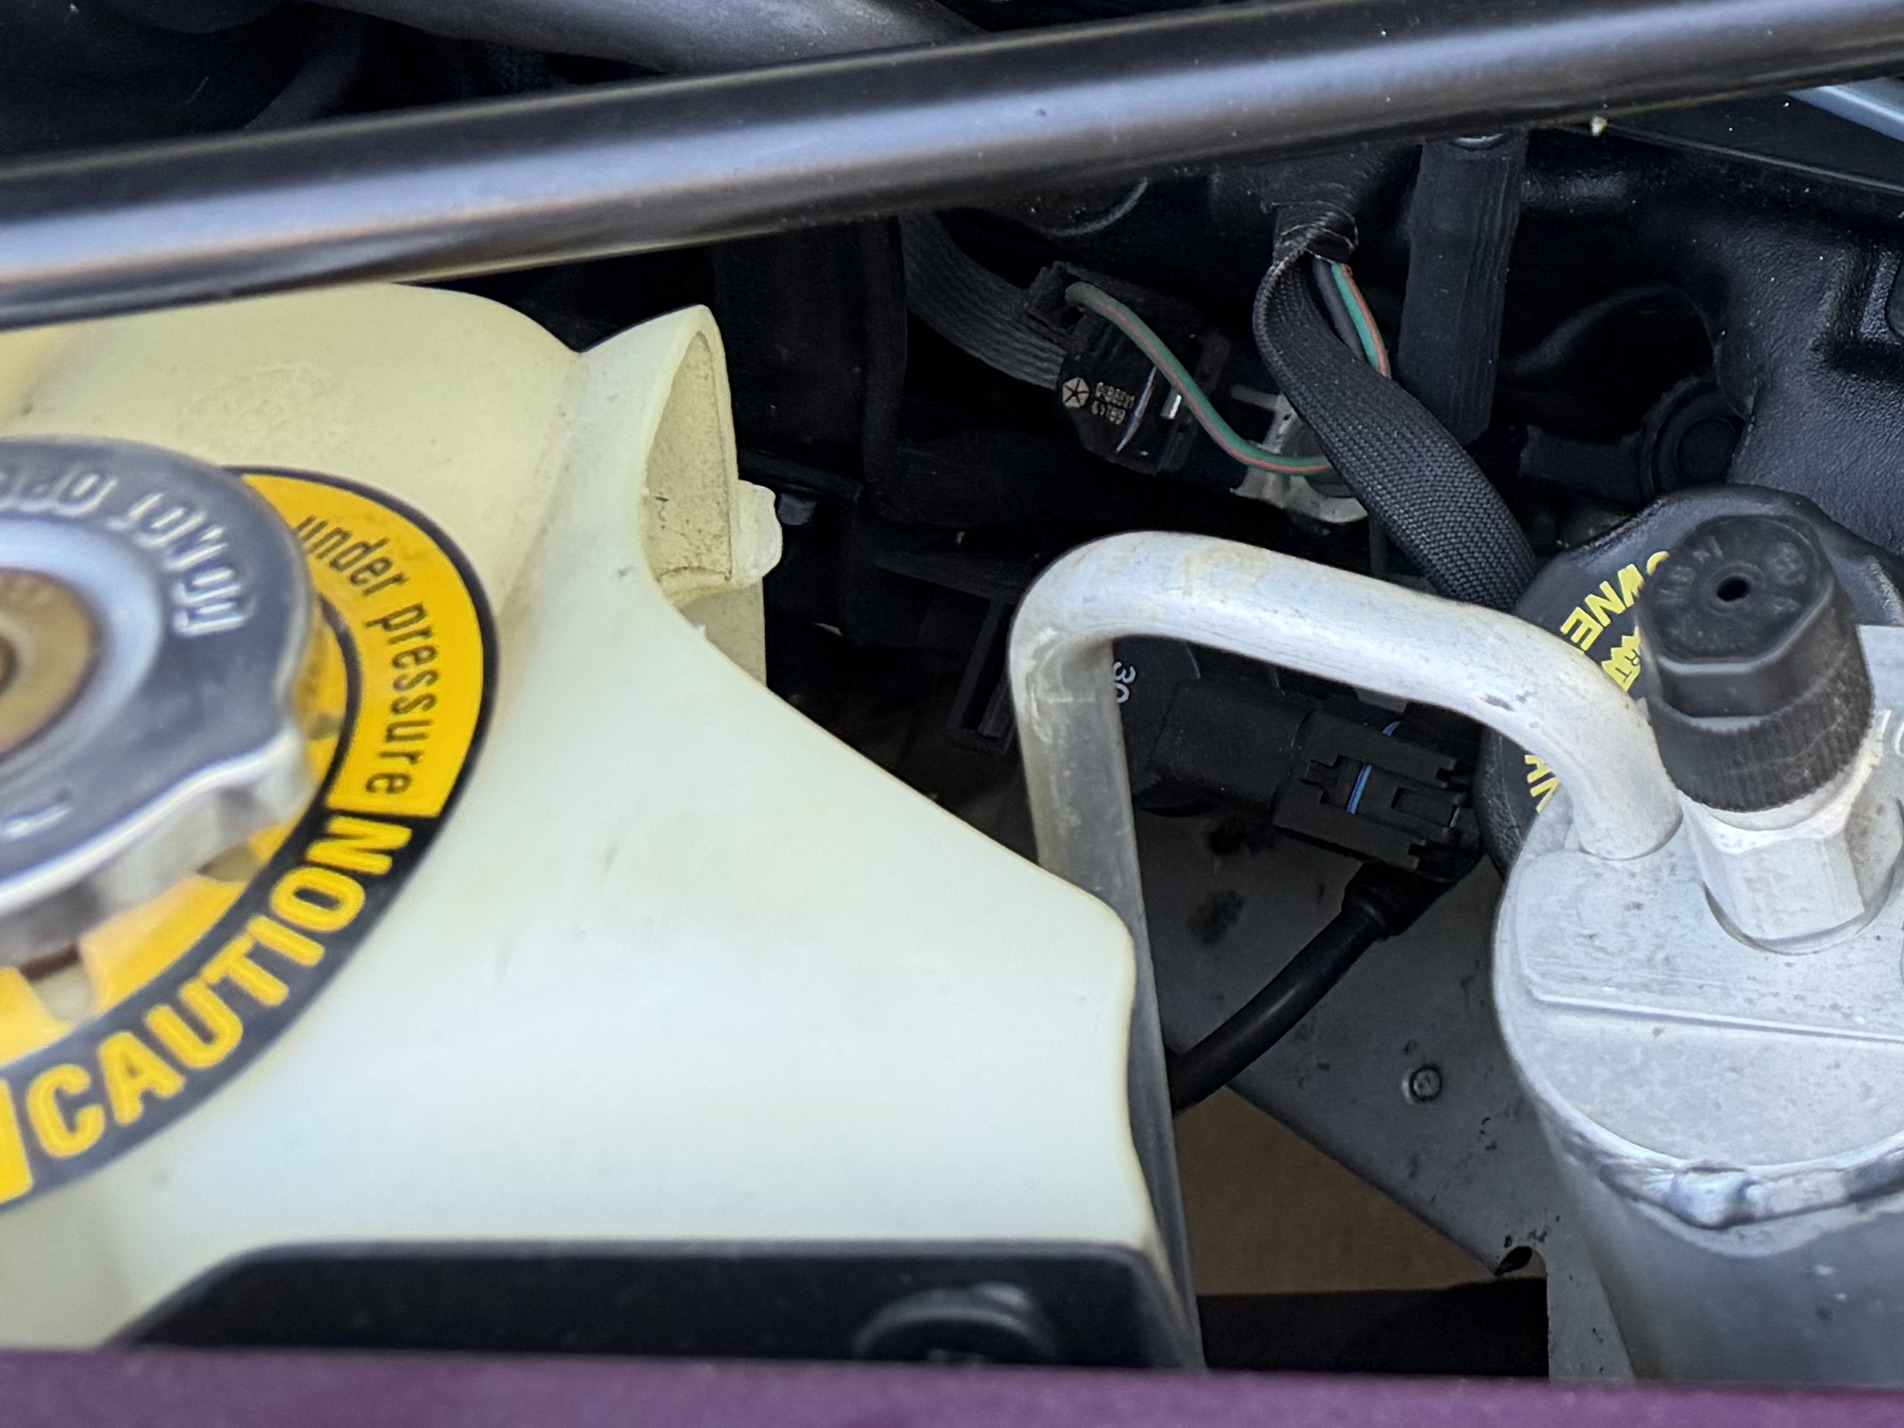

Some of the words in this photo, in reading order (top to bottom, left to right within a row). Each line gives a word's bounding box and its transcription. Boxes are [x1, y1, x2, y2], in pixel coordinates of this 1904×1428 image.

[295, 513, 407, 599] under
[364, 603, 441, 796] pressure
[28, 815, 416, 1158] CAUTION
